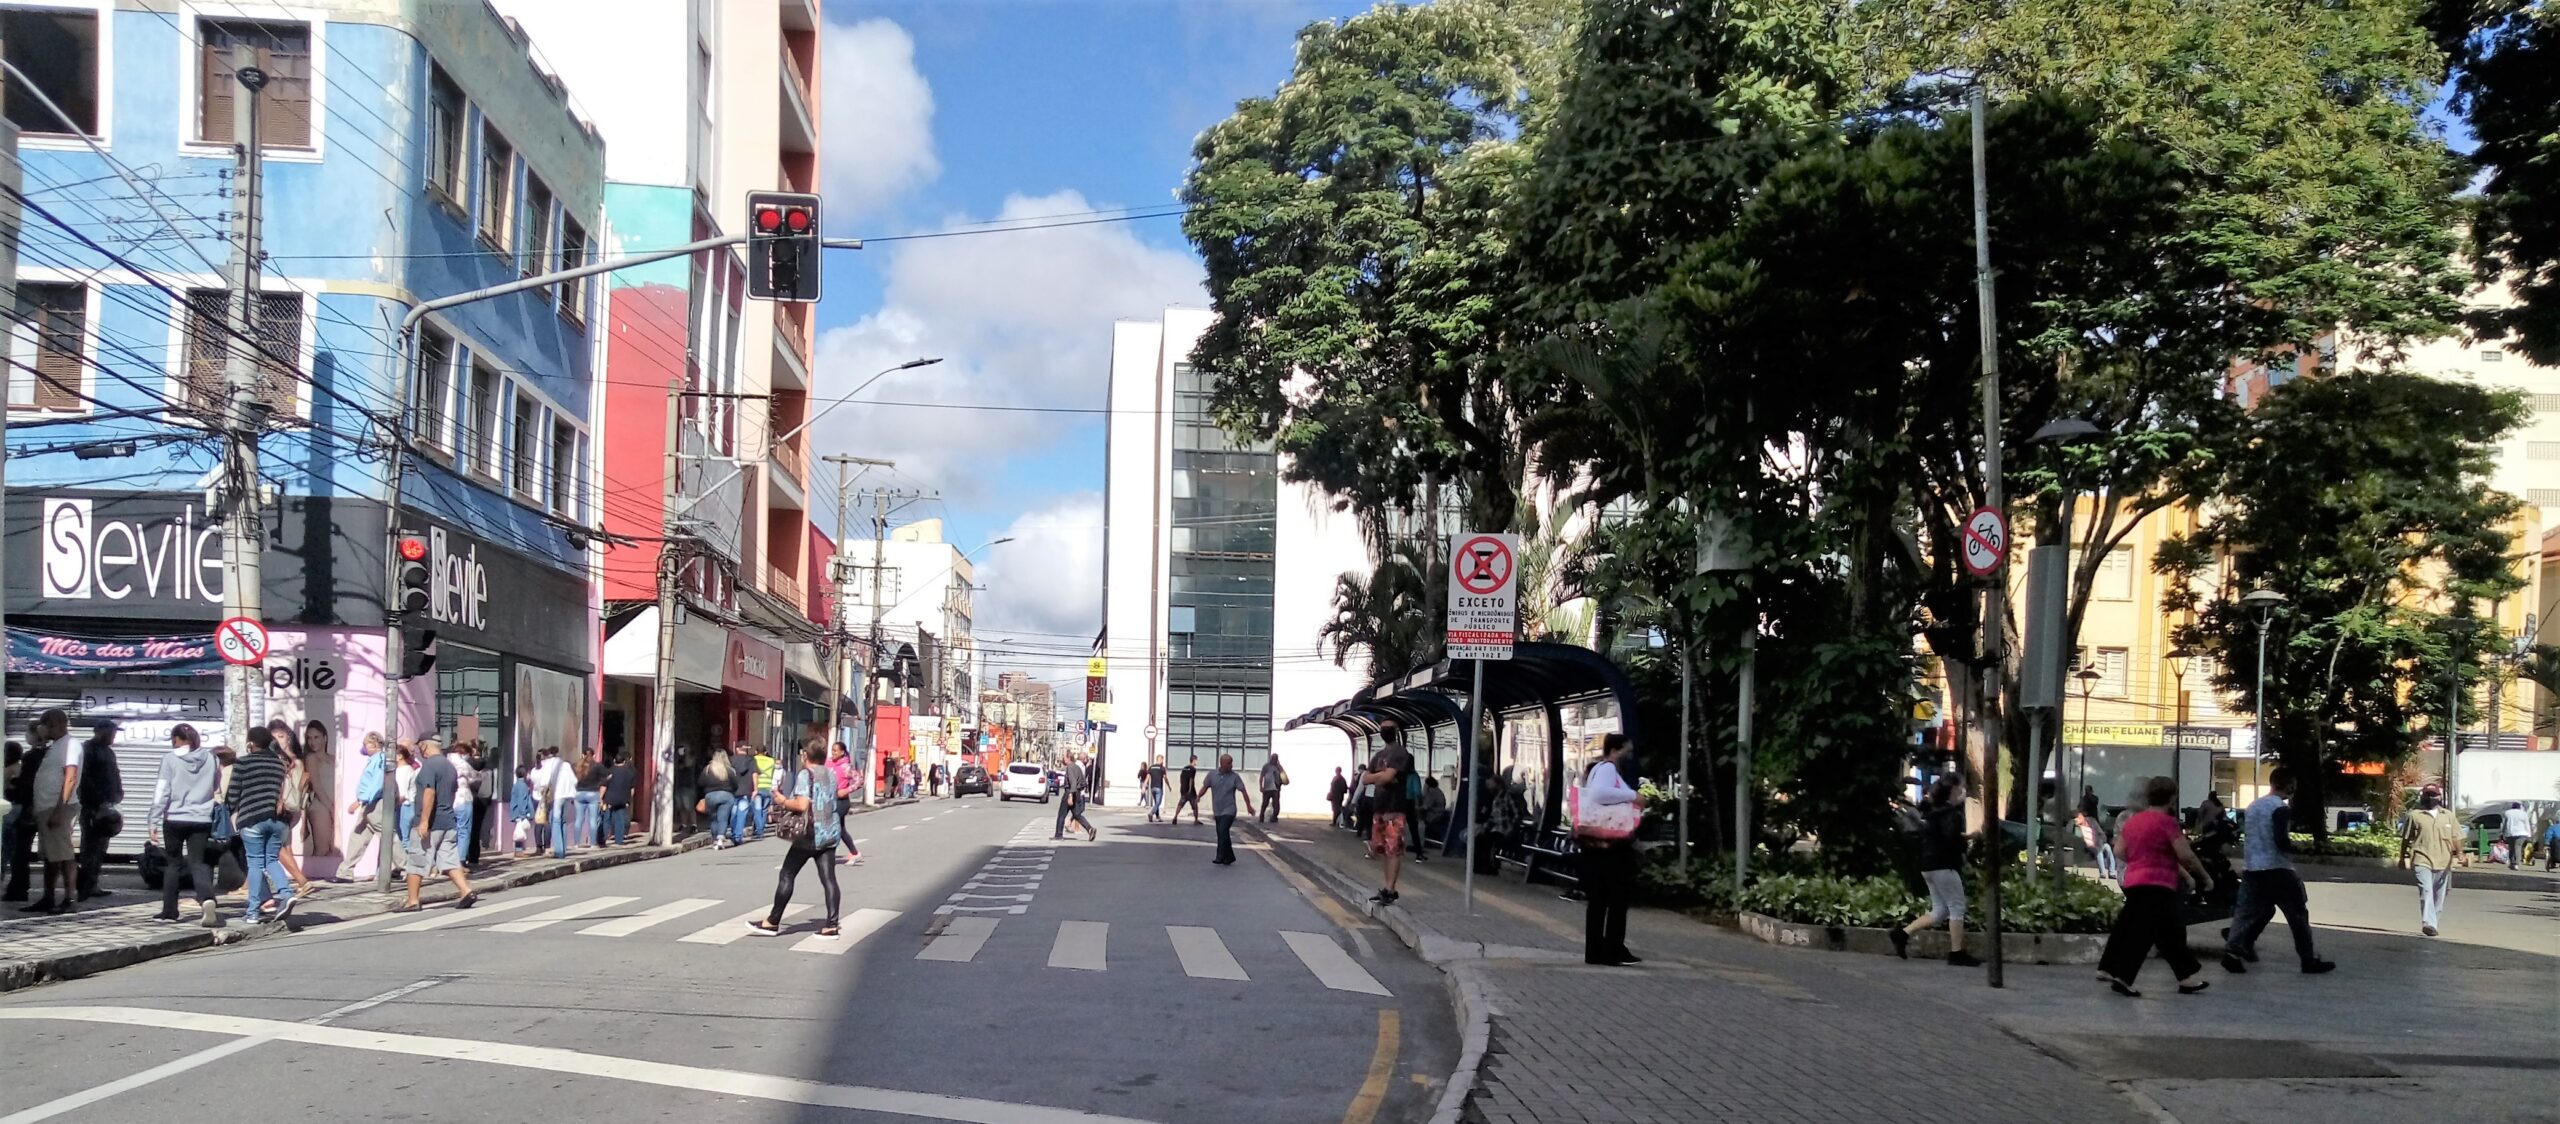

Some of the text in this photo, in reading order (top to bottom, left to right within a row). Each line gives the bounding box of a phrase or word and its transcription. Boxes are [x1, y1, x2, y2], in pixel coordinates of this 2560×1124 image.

[44, 498, 224, 602] Sevile
[431, 526, 487, 631] Sevile
[1458, 597, 1504, 608] EXCETO
[37, 636, 89, 657] Mês
[95, 643, 136, 658] das
[2121, 727, 2159, 736] ELIANE
[2163, 733, 2229, 746] samaria
